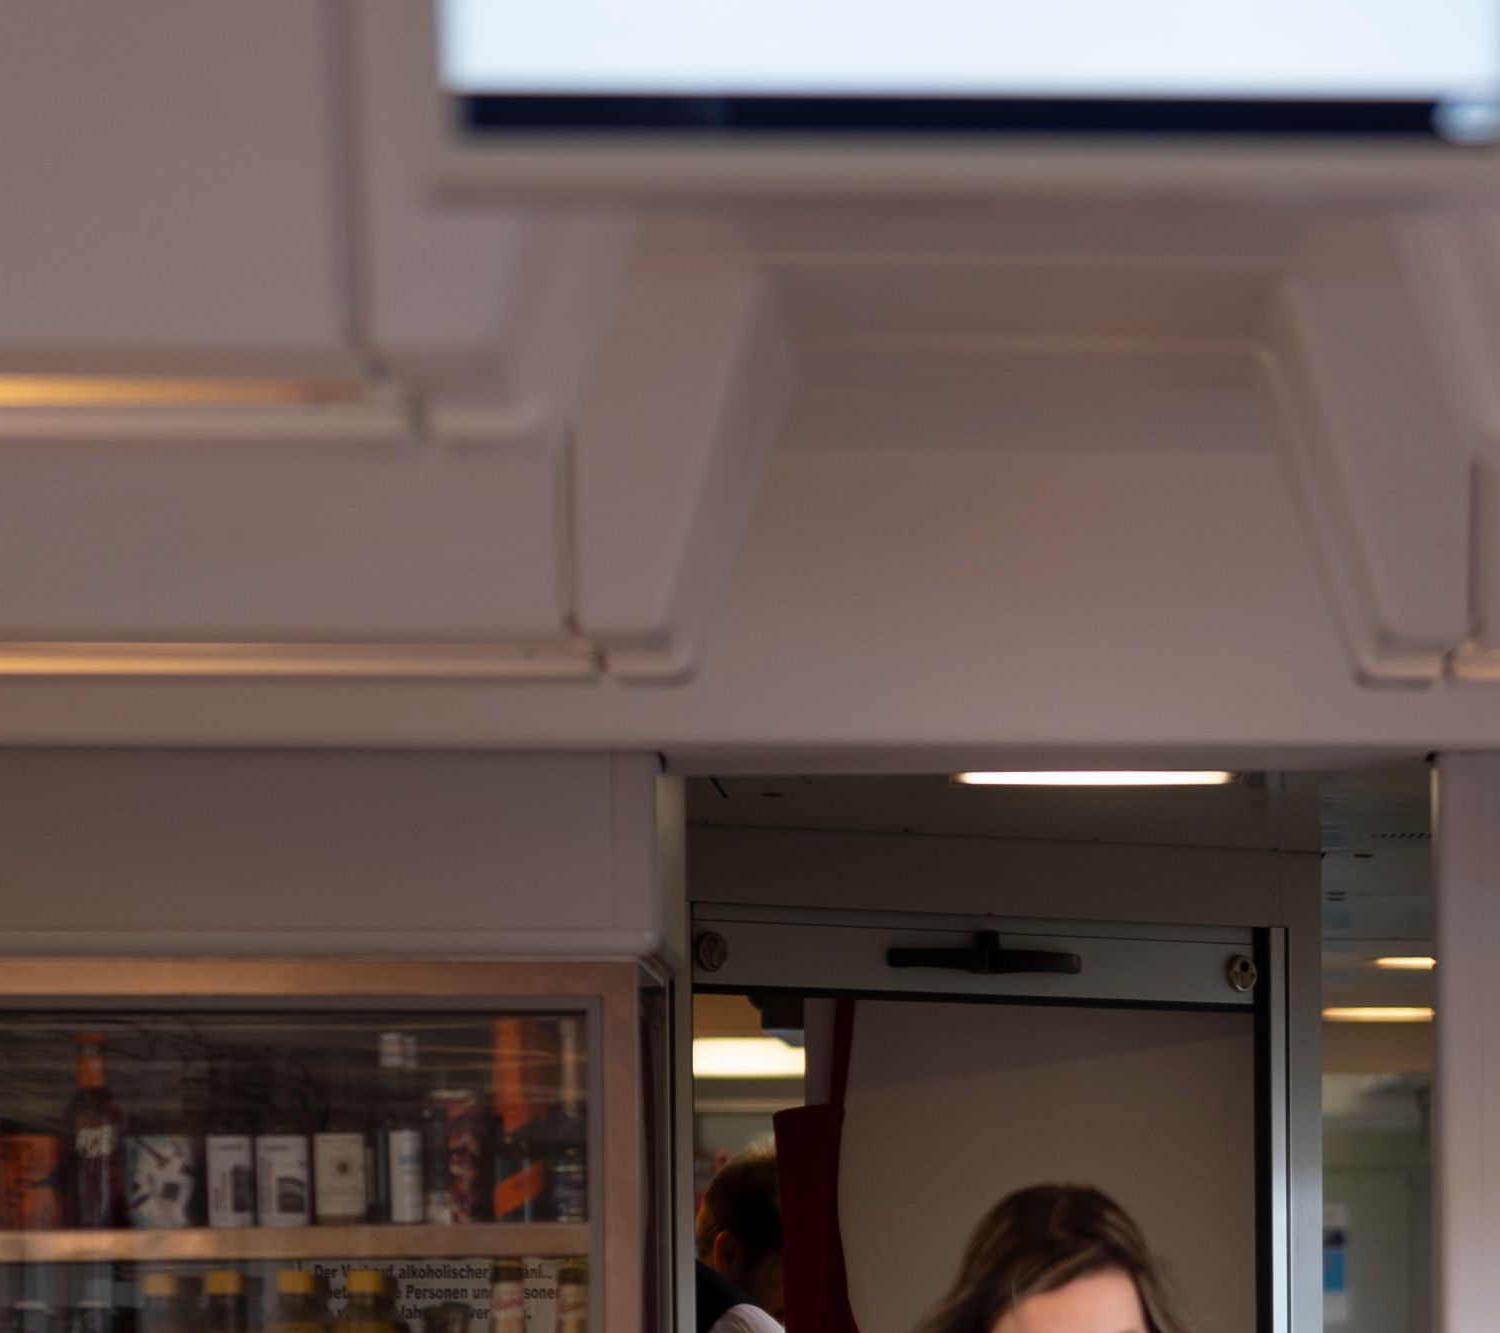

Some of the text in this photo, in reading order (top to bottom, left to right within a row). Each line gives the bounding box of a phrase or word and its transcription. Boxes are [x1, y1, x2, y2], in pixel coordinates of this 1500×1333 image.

[314, 1264, 338, 1280] Der
[398, 1264, 490, 1280] alkoholischer
[405, 1284, 469, 1300] Personen
